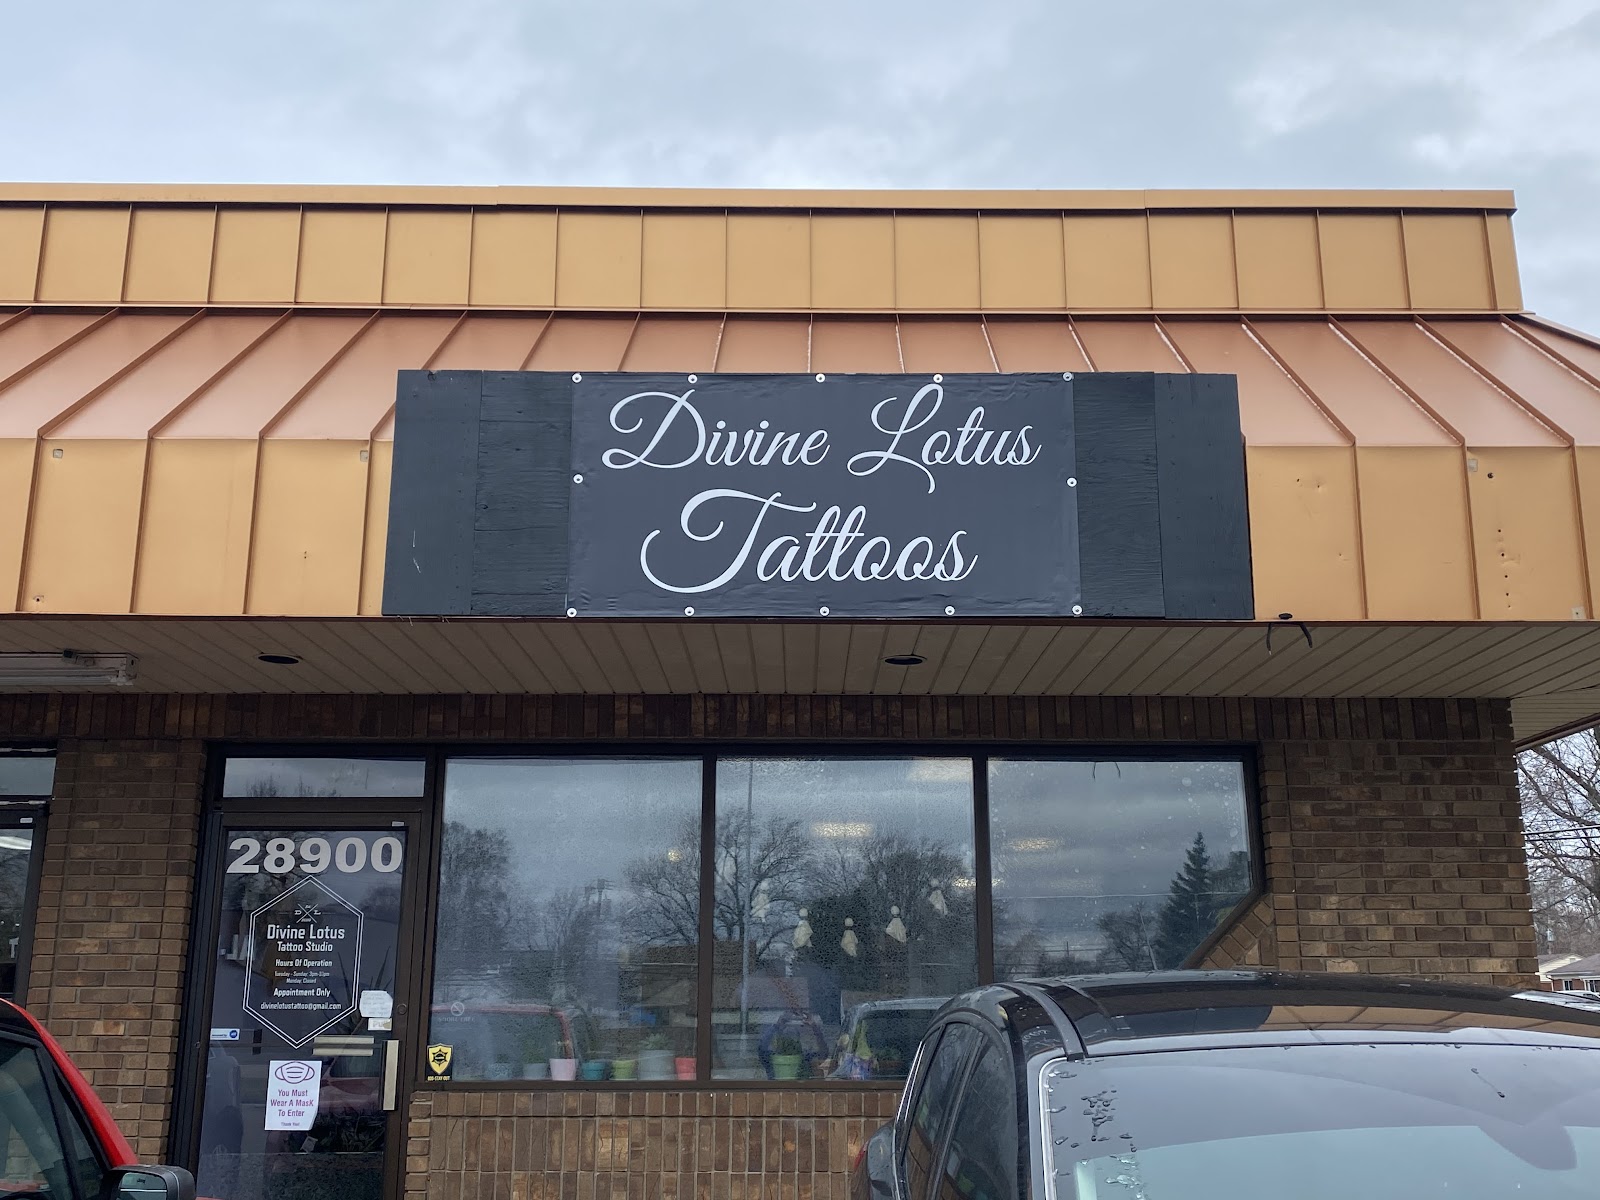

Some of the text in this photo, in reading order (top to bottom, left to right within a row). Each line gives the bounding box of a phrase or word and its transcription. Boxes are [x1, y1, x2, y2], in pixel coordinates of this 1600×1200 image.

[601, 383, 1042, 494] Divine Lotus
[640, 488, 979, 594] Tattoos
[226, 837, 403, 874] 28900
[266, 924, 346, 940] Divine Lotus
[277, 941, 334, 952] Tattoo Studio
[275, 959, 333, 968] Hours Of Operation
[273, 987, 331, 998] Appointment Only
[260, 1002, 342, 1011] divinelotustattoo@gmail.com
[278, 1089, 308, 1097] You Must
[270, 1099, 288, 1107] Wear
[288, 1099, 294, 1107] A
[278, 1109, 305, 1117] To Enter
